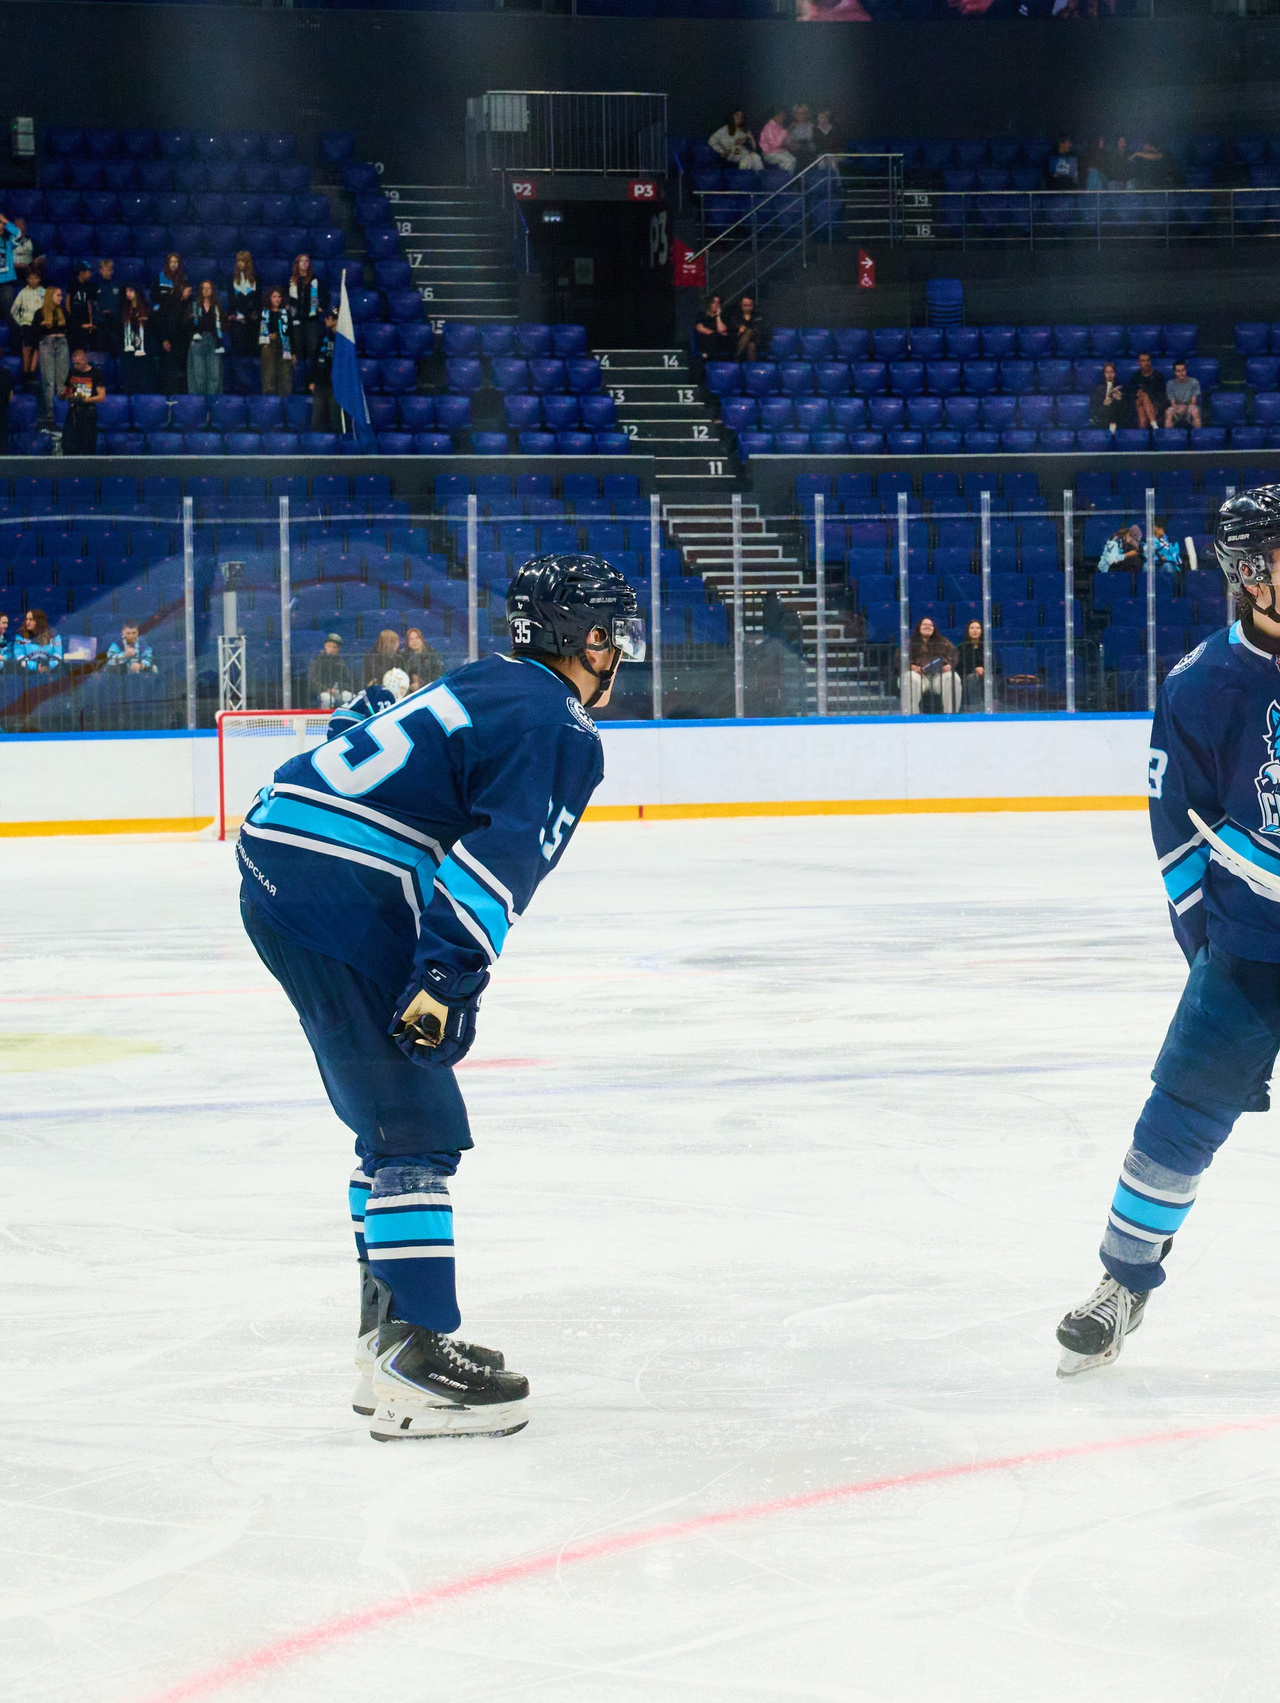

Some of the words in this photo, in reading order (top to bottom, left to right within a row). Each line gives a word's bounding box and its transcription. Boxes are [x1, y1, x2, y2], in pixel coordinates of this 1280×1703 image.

[384, 190, 400, 201] 19
[512, 183, 533, 196] P2
[634, 184, 654, 198] P3
[914, 194, 929, 206] 19
[396, 221, 412, 235] 18
[915, 224, 932, 237] 18
[407, 253, 423, 267] 17
[430, 320, 446, 334] 15
[662, 354, 679, 369] 14
[609, 389, 625, 403] 13
[677, 389, 694, 403] 13
[622, 425, 639, 439] 12
[692, 425, 709, 439] 12
[709, 461, 723, 475] 11
[514, 621, 531, 643] 35
